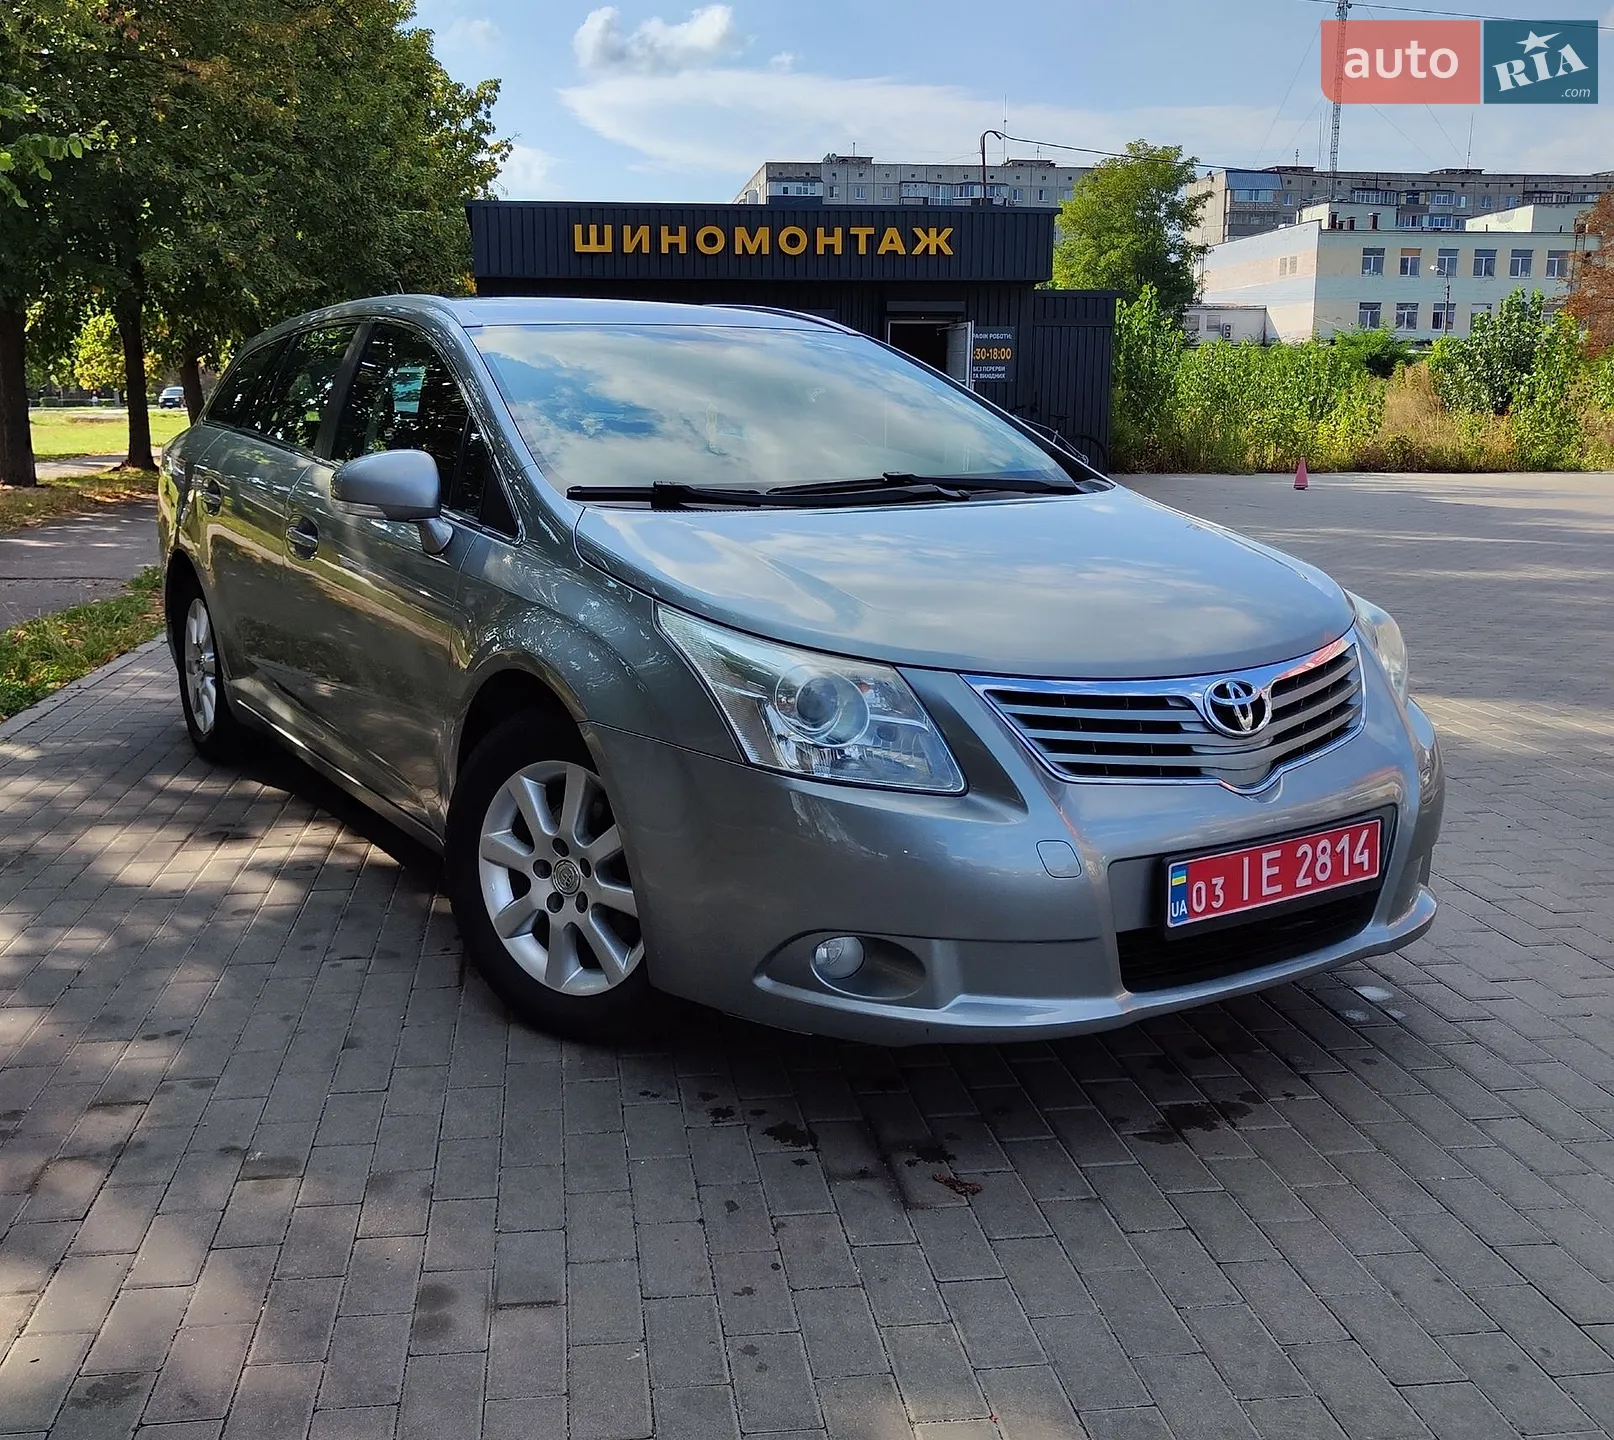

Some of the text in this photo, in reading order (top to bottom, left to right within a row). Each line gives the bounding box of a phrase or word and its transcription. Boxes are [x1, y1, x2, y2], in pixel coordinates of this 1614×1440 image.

[573, 223, 954, 256] ШИНОМОНТАЖ
[973, 347, 1012, 360] :30-18:00
[1192, 876, 1225, 913] 03
[1295, 829, 1370, 888] 2814
[1171, 899, 1188, 918] UA
